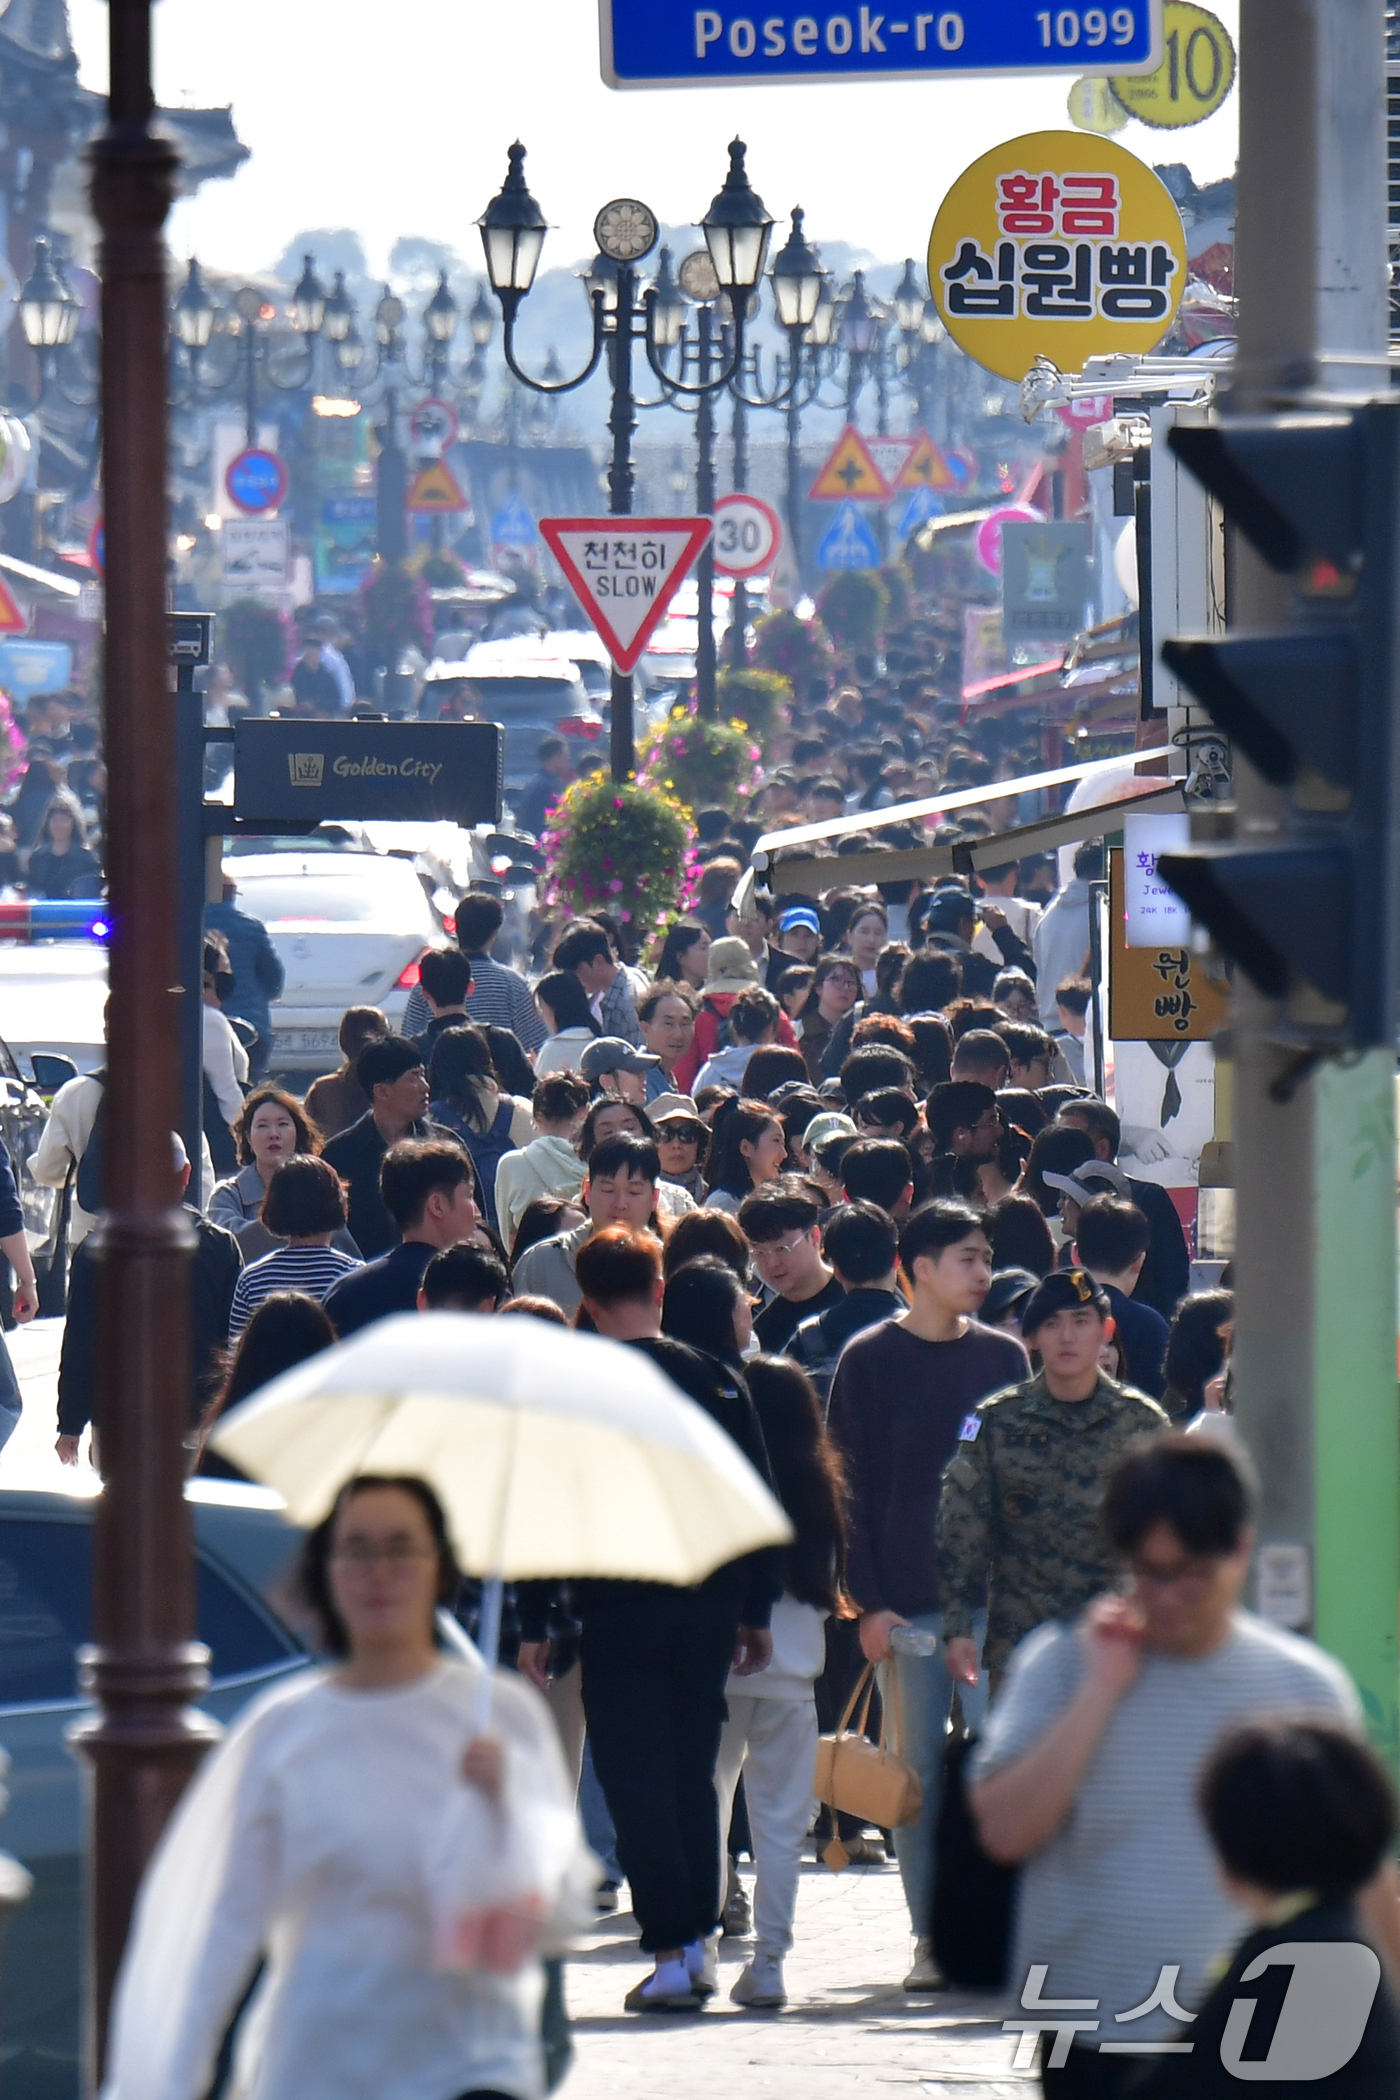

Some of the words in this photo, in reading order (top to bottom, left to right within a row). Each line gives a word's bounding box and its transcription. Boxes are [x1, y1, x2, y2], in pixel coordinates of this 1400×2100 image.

[695, 6, 965, 58] Poseok-ro
[1036, 9, 1136, 48] 1099
[1166, 27, 1222, 102] 10
[998, 174, 1118, 235] 황금
[943, 241, 1175, 319] 십원빵
[719, 519, 760, 553] 30
[584, 541, 666, 570] 천천히
[597, 575, 657, 598] SLOW
[333, 754, 398, 777] Golden
[400, 757, 443, 785] City
[1140, 906, 1157, 915] 24K
